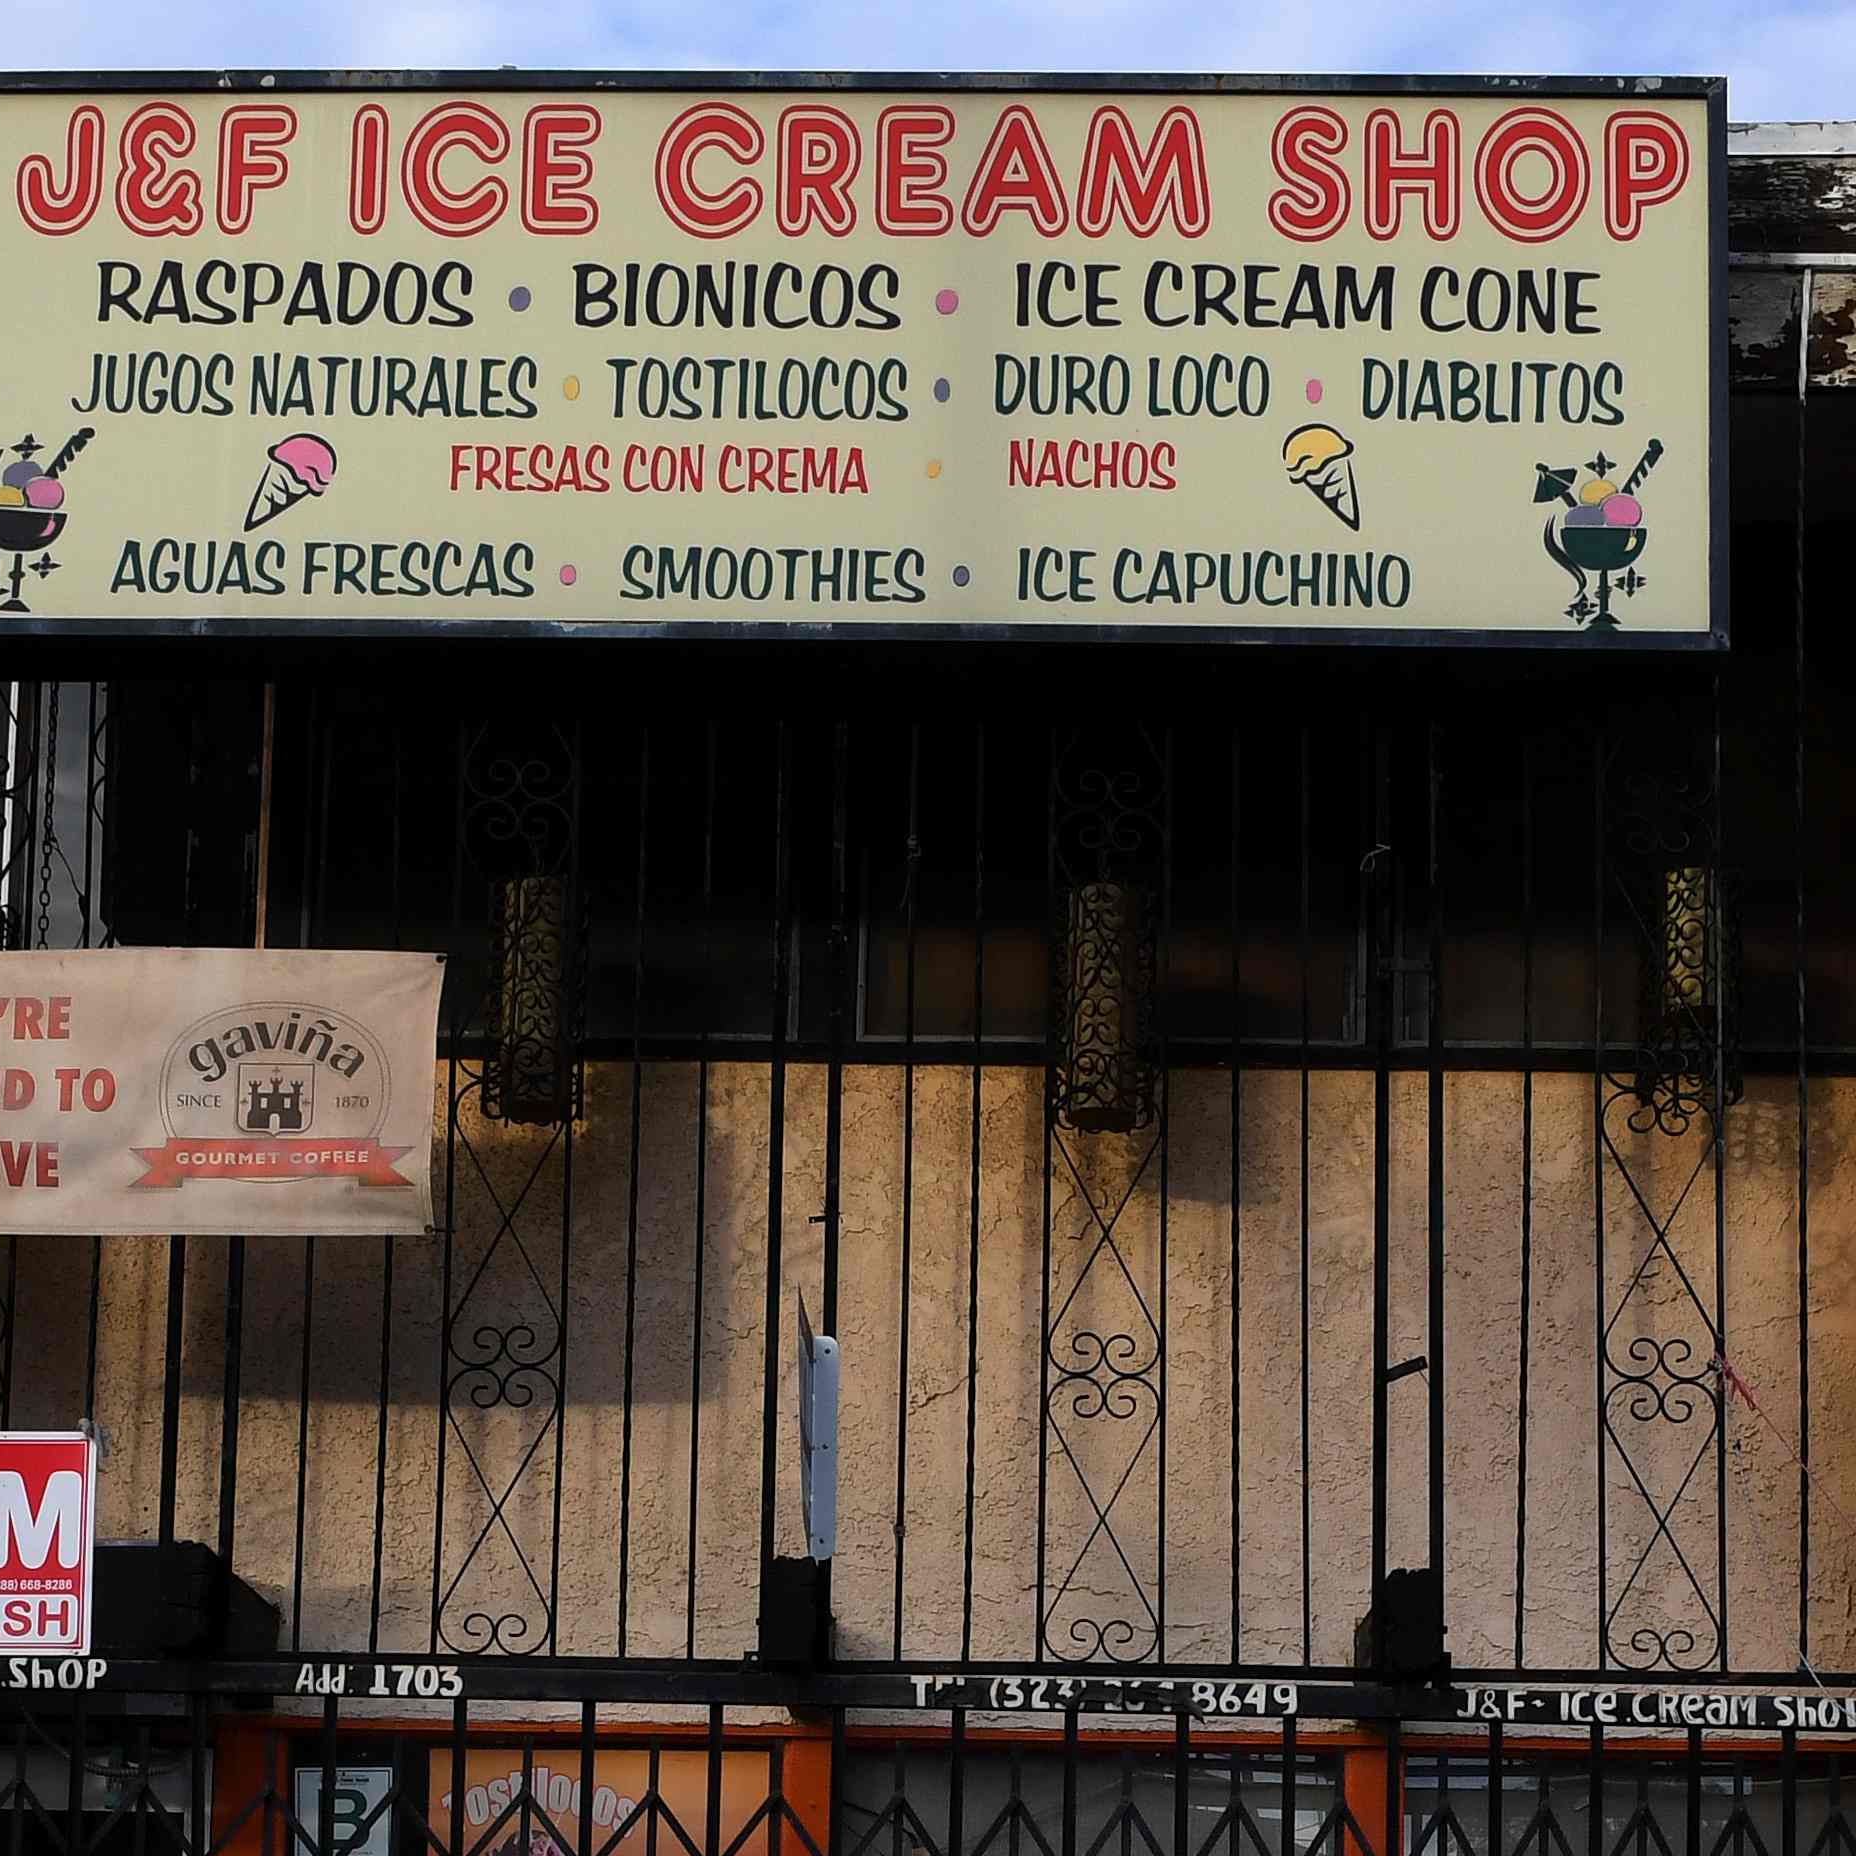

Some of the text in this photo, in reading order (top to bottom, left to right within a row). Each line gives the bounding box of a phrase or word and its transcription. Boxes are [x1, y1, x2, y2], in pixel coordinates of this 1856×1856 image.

[16, 102, 1690, 243] J&F ICE CREAM SHOP
[97, 259, 474, 327] RASPADOS
[572, 260, 901, 330] BIONICOS
[1015, 261, 1602, 334] ICE CREAM CONE
[72, 351, 538, 419] JUGOS NATURALES
[606, 356, 909, 422] TOSTILOCOS
[994, 353, 1270, 418] DURO LOCO
[1361, 358, 1626, 425] DIABLITOS
[450, 444, 869, 495] FRESAS CON CREMA
[1008, 438, 1177, 491] NACHOS
[110, 539, 535, 598] AGUAS FRESCAS
[619, 544, 926, 603] SMOOTHIES
[1017, 546, 1411, 609] ICE CAPUCHINO
[188, 1012, 365, 1083] gaviña
[55, 1067, 117, 1113] TO
[176, 1093, 222, 1109] SINCE
[334, 1095, 370, 1109] 1870
[175, 1150, 370, 1166] GOURMET COFFEE
[369, 1664, 463, 1697] 1703
[1191, 1682, 1299, 1714] 8649
